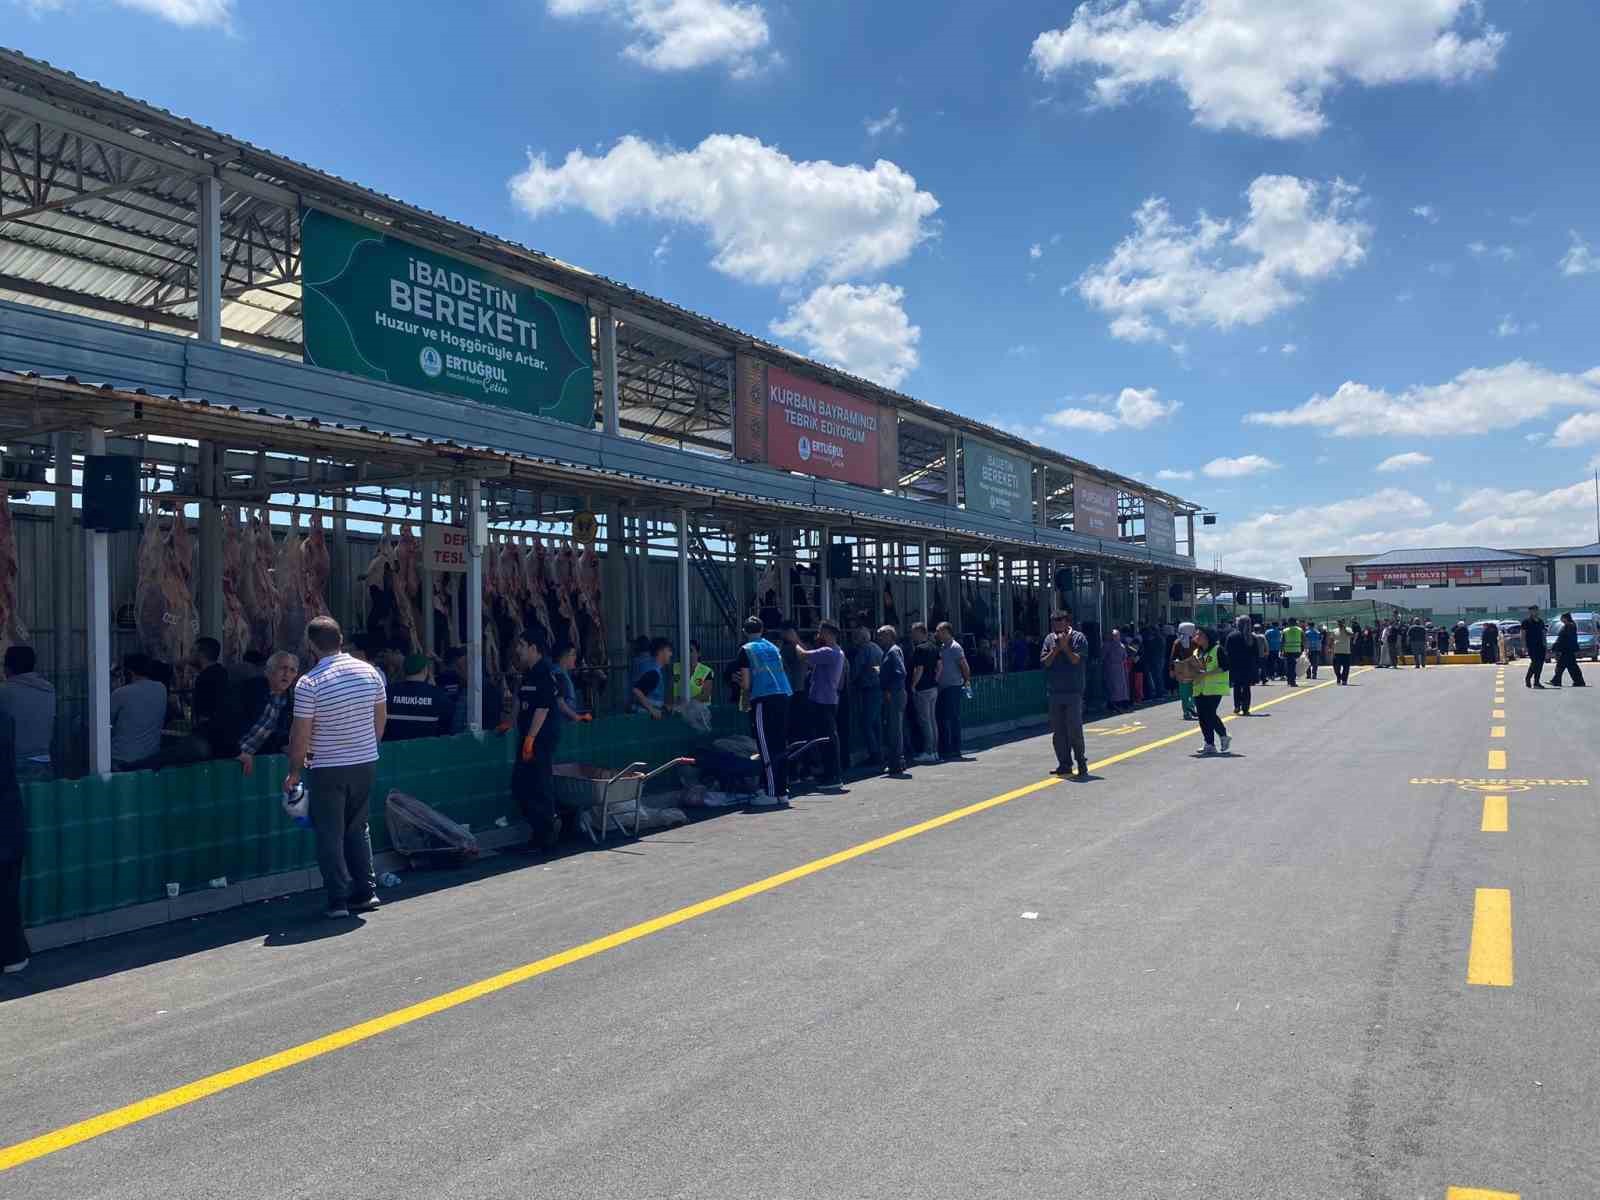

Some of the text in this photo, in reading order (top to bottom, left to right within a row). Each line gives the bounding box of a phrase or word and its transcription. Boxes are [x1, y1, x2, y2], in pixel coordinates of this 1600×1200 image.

[390, 278, 538, 350] BEREKETİ
[375, 311, 549, 372] Huzur ve Hoşgörüyle Artar.
[446, 354, 507, 383] ERTUĞRUL
[769, 384, 816, 413] KURBAN
